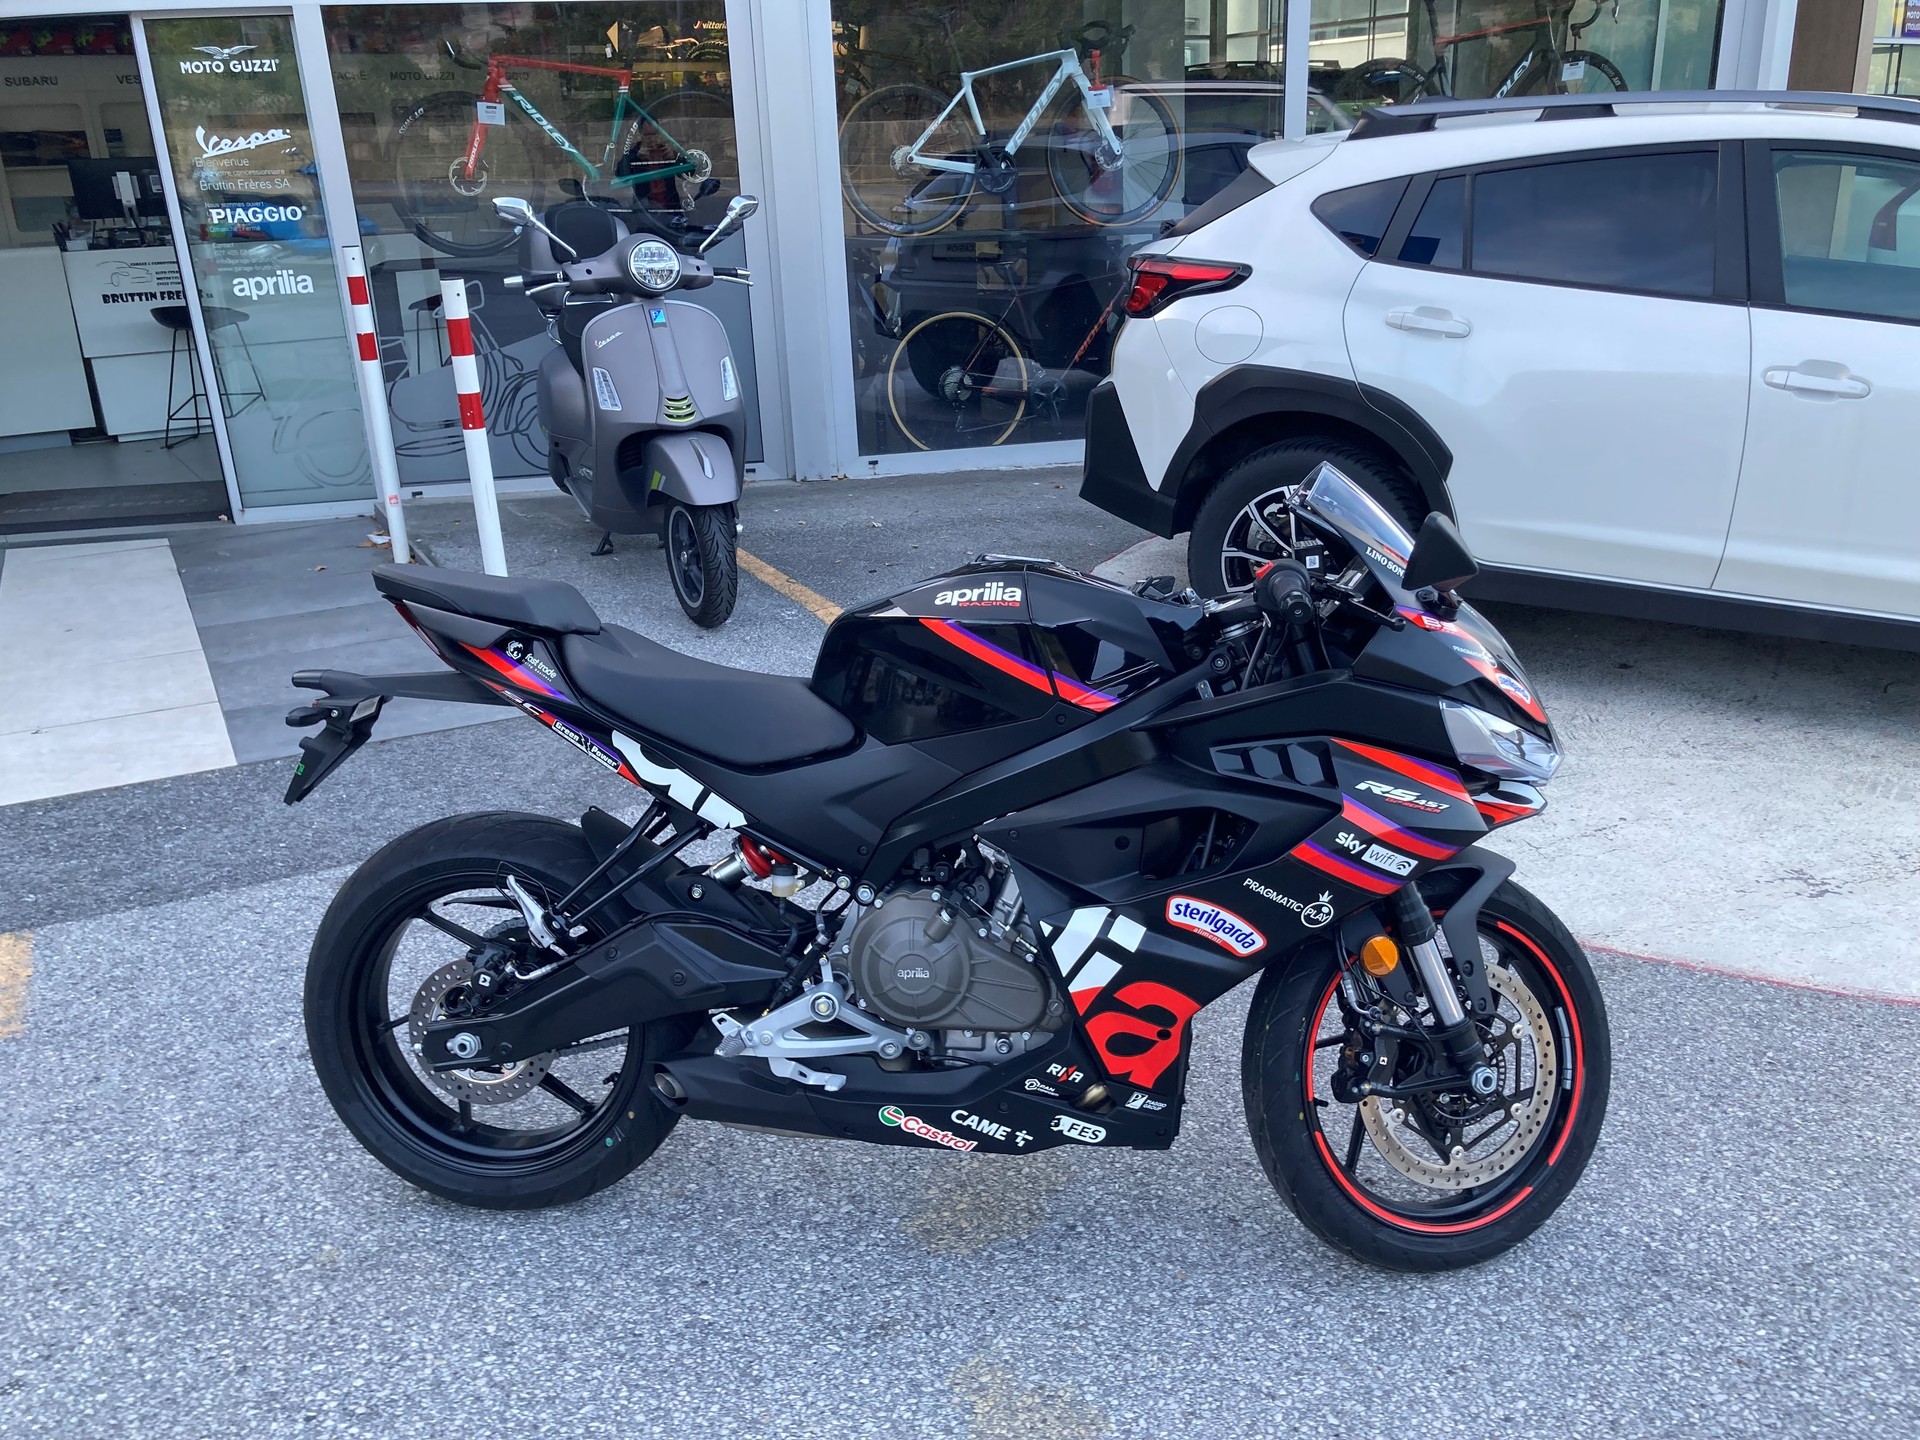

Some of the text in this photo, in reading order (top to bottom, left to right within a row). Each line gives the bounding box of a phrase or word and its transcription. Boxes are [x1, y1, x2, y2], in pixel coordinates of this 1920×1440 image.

[180, 60, 225, 74] MOTO
[389, 71, 422, 81] MOTO
[4, 75, 59, 87] SUBARU
[513, 95, 579, 154] RIDLEY
[195, 125, 292, 158] Vespa
[467, 130, 481, 169] RIDLEY
[195, 157, 250, 168] Bienvenue
[200, 178, 292, 191] Bruttin Frères SA
[209, 205, 303, 224] PIAGGIO
[101, 291, 157, 304] BRUTTIN
[232, 269, 315, 300] aprilia
[1365, 546, 1388, 566] LINO
[1387, 562, 1405, 579] SON
[934, 581, 1022, 606] aprilia
[525, 652, 540, 667] fast
[537, 661, 557, 679] trade
[555, 721, 618, 767] Green Power
[1354, 779, 1452, 810] RS 457
[1335, 829, 1398, 868] sky wifi
[1242, 877, 1304, 912] PRAGMATIC
[1173, 902, 1256, 949] sterilgarda
[1304, 906, 1330, 923] PLAY
[1193, 927, 1225, 945] alimenti
[896, 966, 931, 980] aprilia
[902, 1114, 977, 1152] Castrol
[950, 1109, 1012, 1142] CAME
[1066, 1121, 1102, 1140] FES
